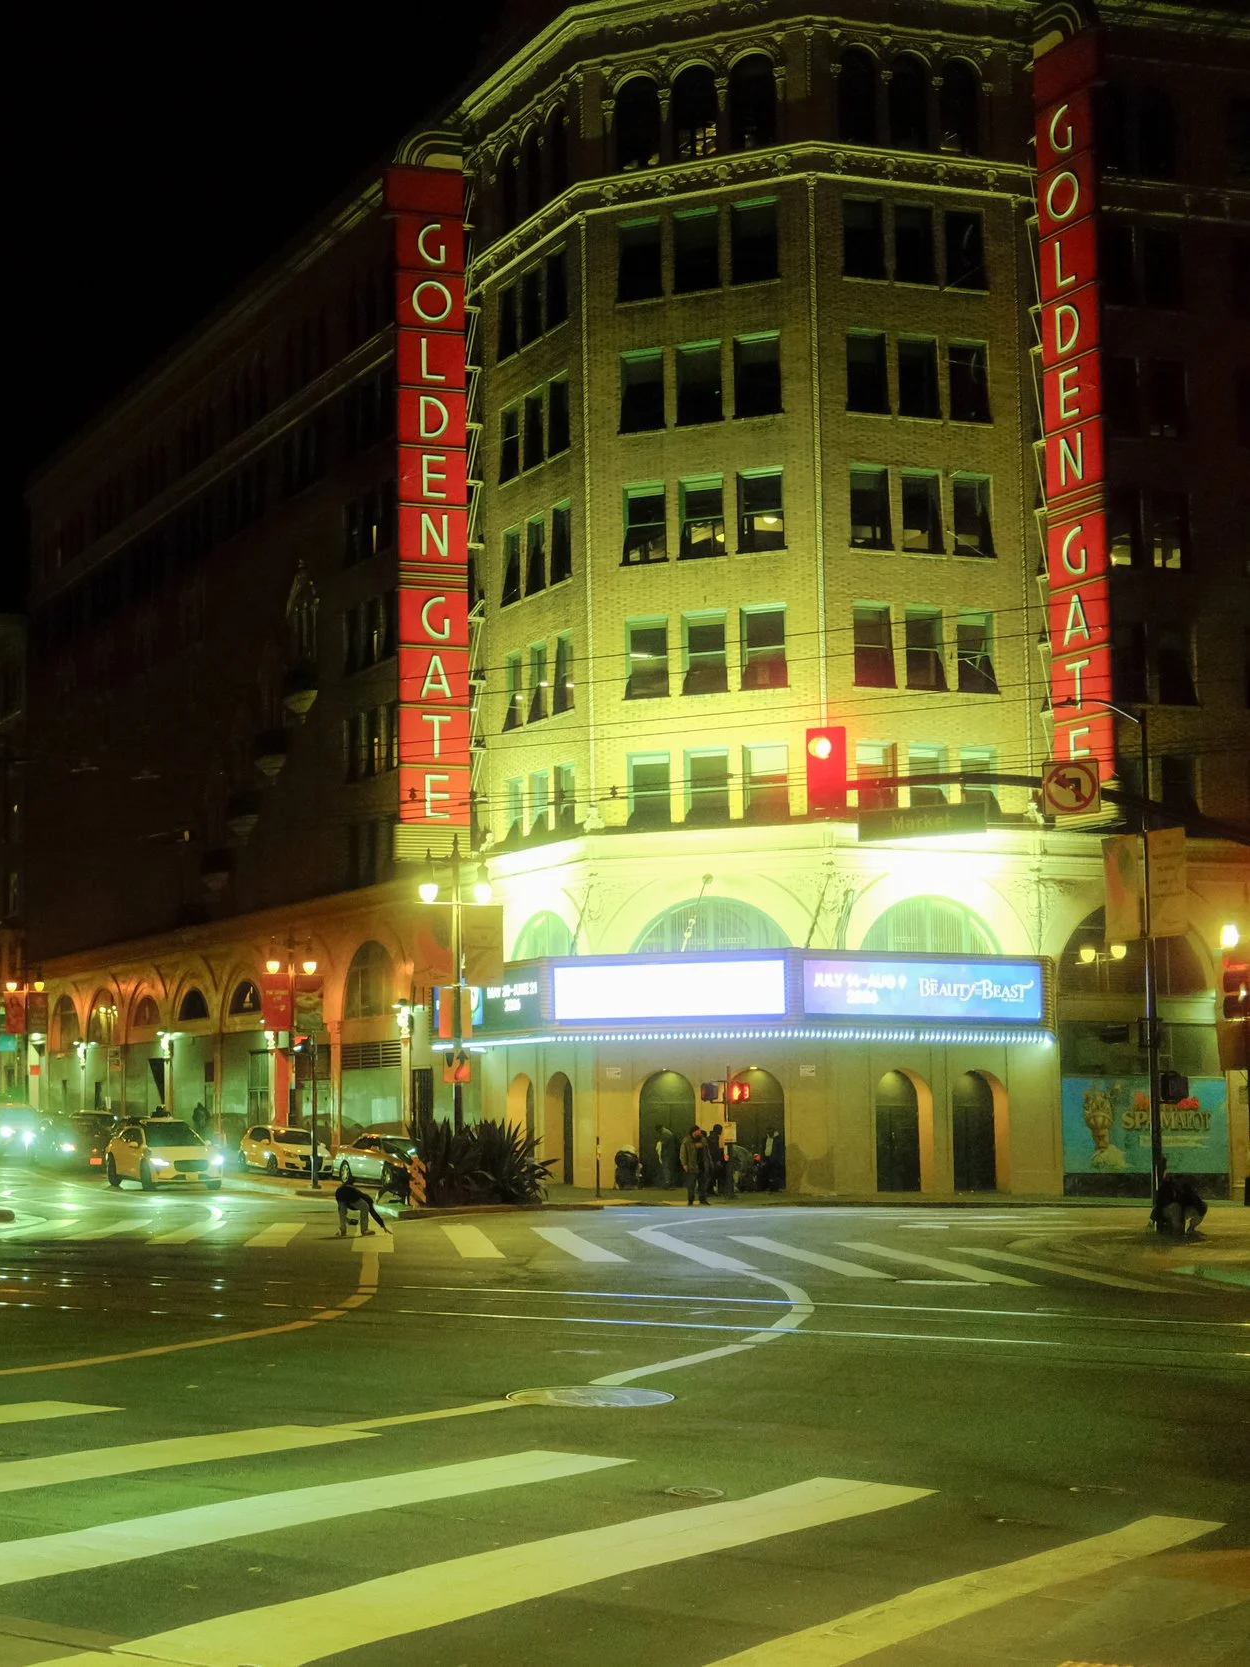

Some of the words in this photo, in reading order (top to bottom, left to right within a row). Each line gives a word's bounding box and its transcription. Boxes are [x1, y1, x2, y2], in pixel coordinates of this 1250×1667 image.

[412, 223, 453, 559] GOLDEN
[1046, 104, 1085, 487] GOLDEN
[420, 595, 452, 821] GATE
[891, 813, 951, 832] Market
